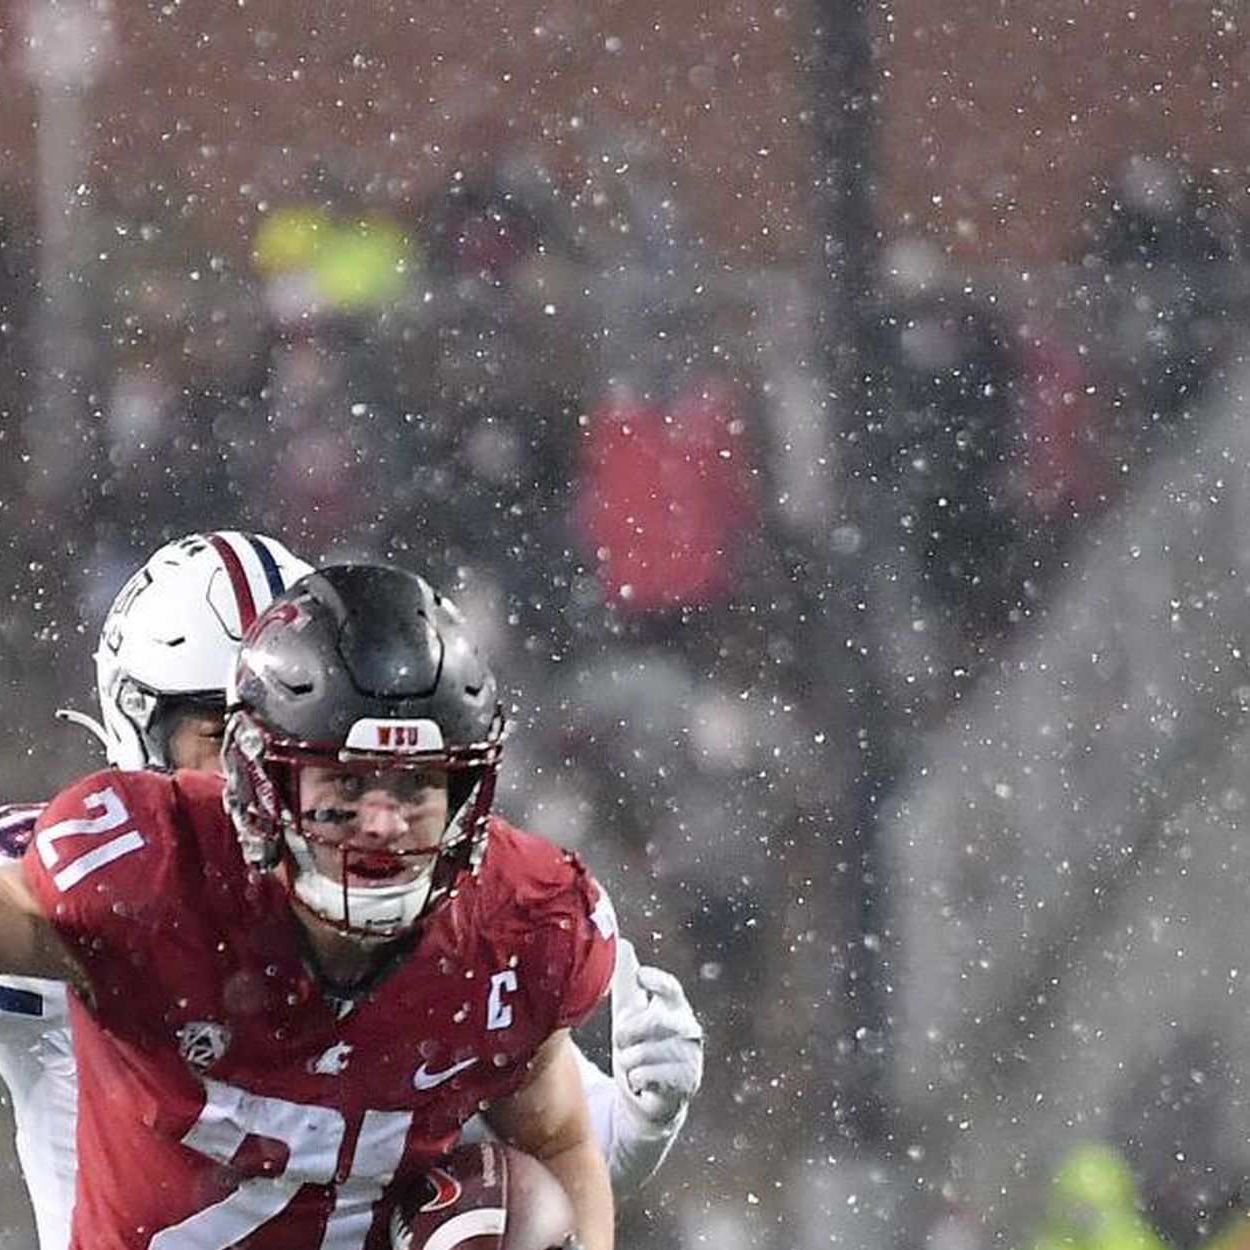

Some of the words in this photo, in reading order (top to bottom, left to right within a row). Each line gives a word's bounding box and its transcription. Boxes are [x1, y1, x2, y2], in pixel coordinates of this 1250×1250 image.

[377, 727, 419, 746] WSU
[35, 785, 146, 892] 21
[486, 970, 518, 1031] C
